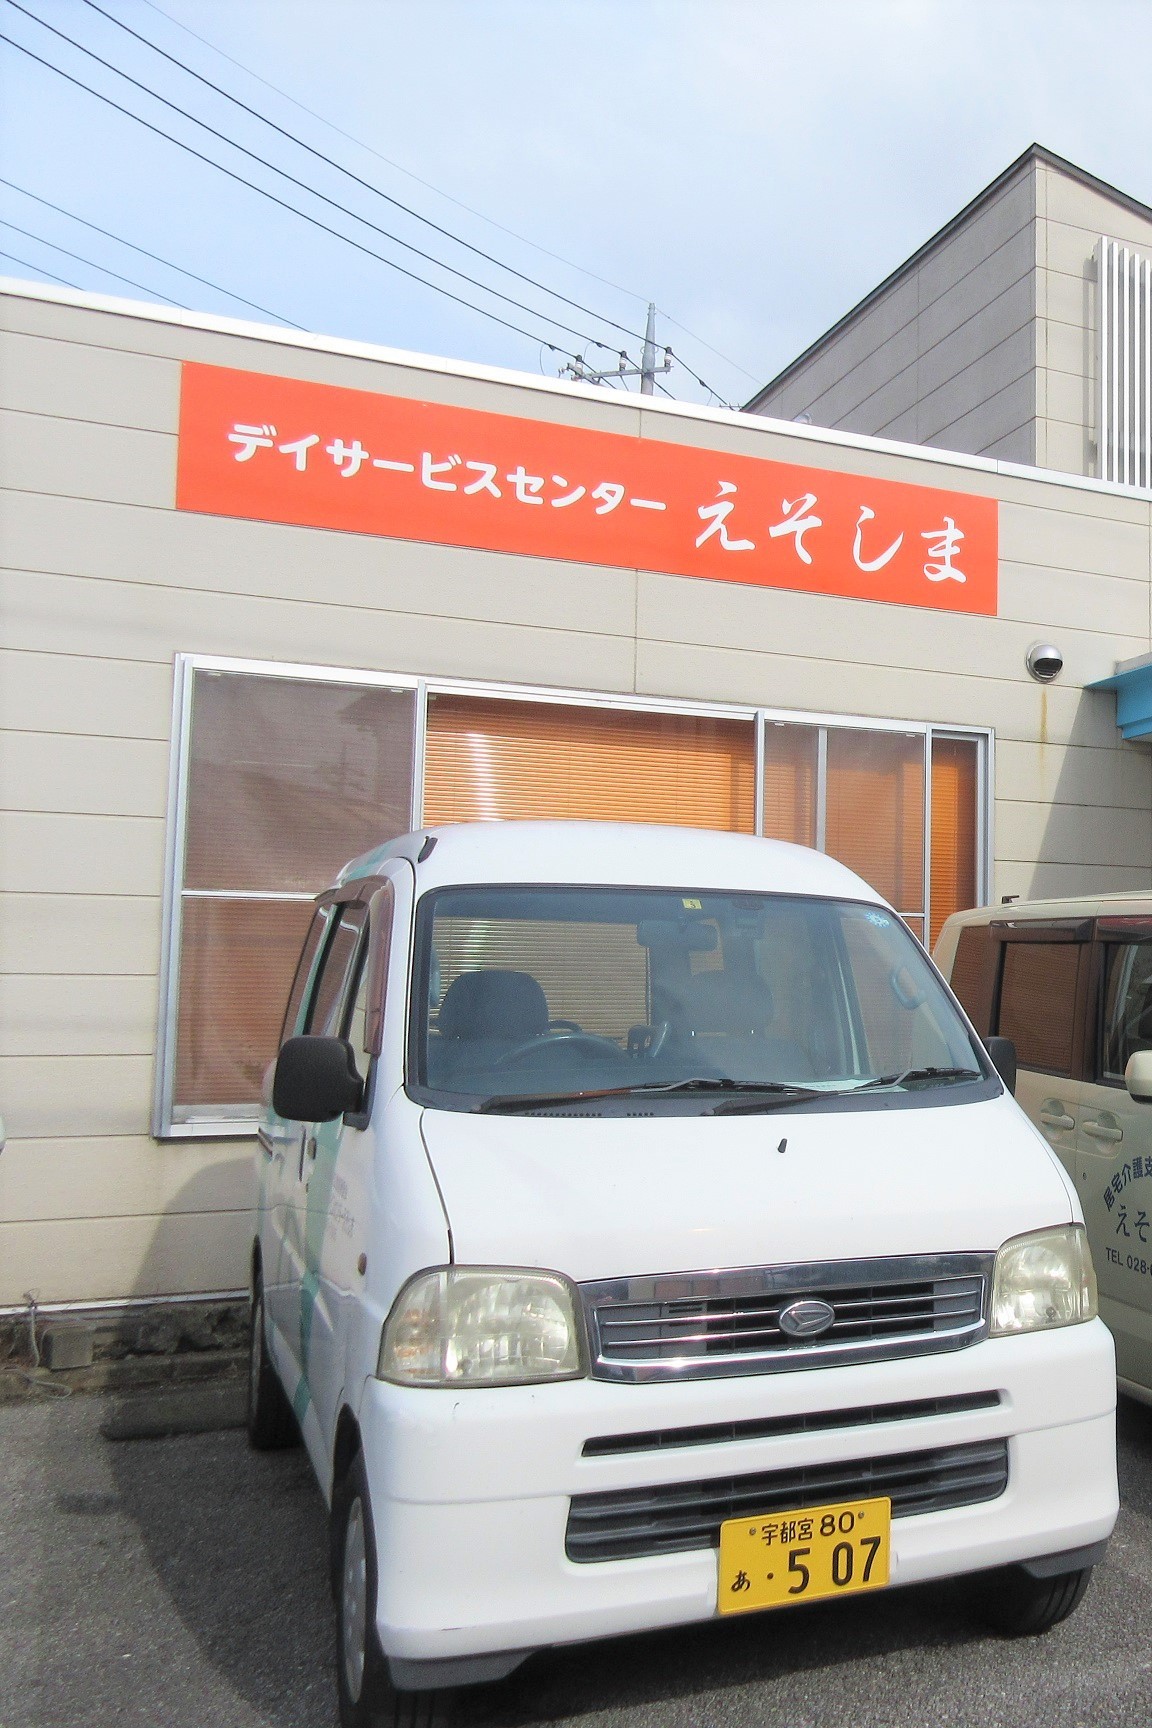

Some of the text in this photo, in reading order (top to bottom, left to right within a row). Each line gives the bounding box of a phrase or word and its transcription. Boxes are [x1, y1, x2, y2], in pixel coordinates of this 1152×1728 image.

[227, 423, 968, 584] デイサービスセンター えそしま
[1105, 1246, 1124, 1267] TEL
[730, 1569, 752, 1593] あ
